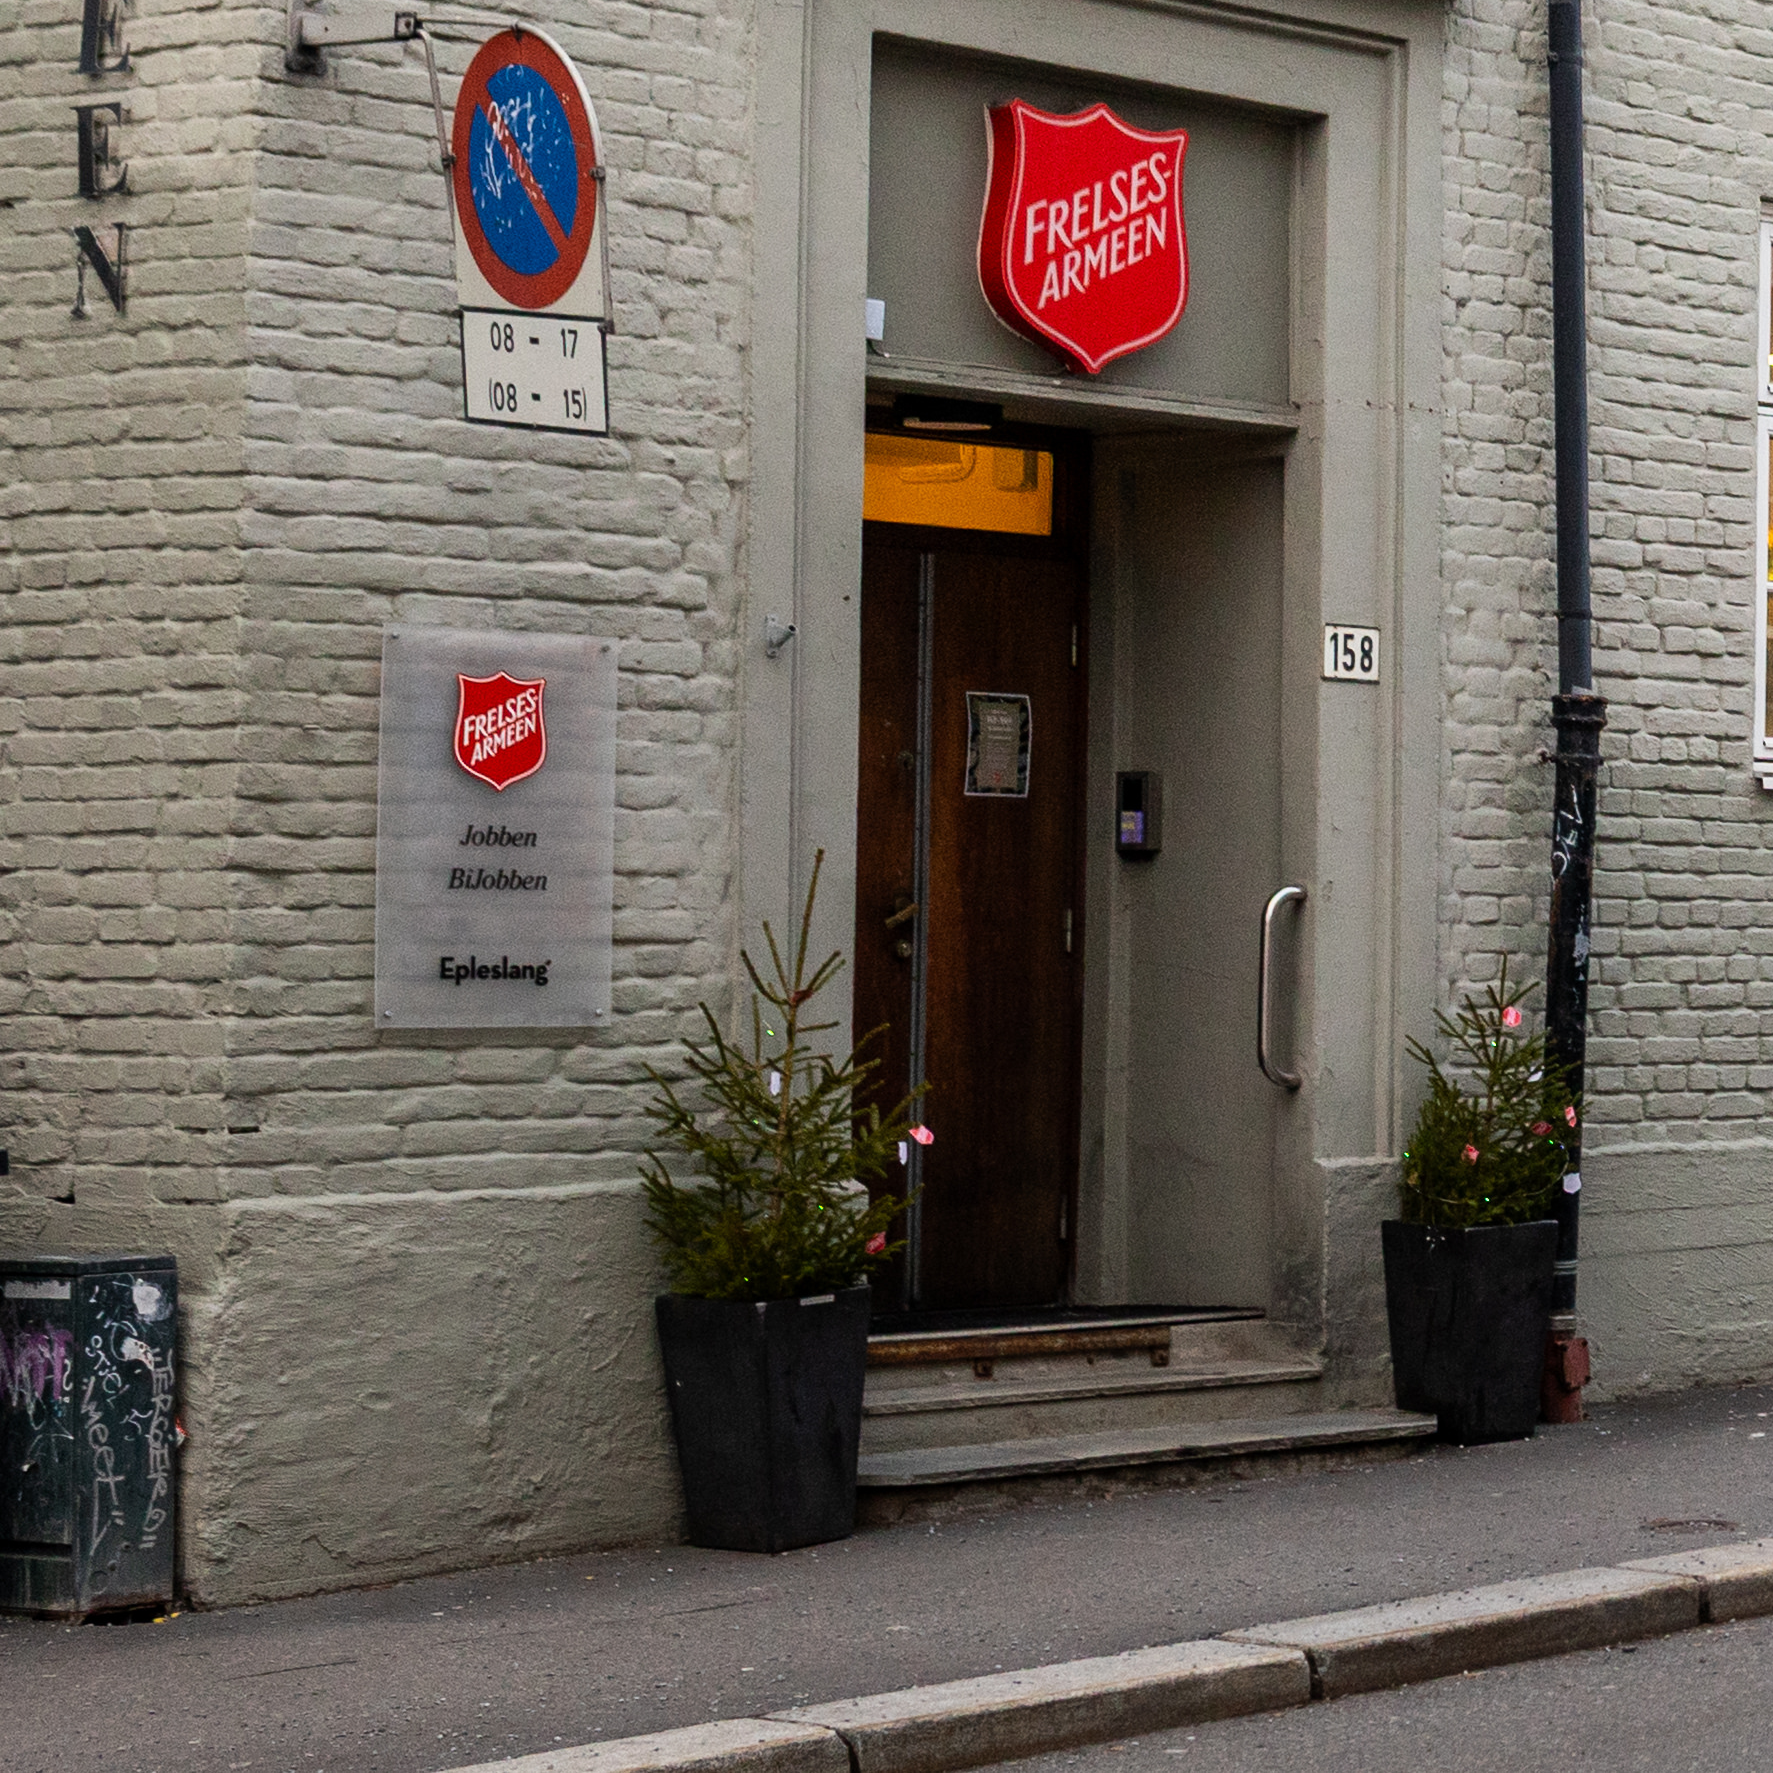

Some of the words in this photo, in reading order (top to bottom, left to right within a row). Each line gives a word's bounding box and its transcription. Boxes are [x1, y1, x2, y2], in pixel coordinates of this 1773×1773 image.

[1023, 150, 1172, 266] FRELSES-
[1036, 207, 1168, 311] ARMEEN
[490, 322, 514, 352] 08
[561, 329, 578, 358] 17
[488, 377, 519, 414] (08
[563, 387, 587, 421] 15)
[1329, 631, 1374, 674] 158
[462, 687, 539, 747] FRELSES-
[470, 711, 537, 767] ARMEEN
[459, 825, 537, 848] Jobben
[447, 867, 547, 892] BiJobben
[440, 956, 550, 987] Epleslang
